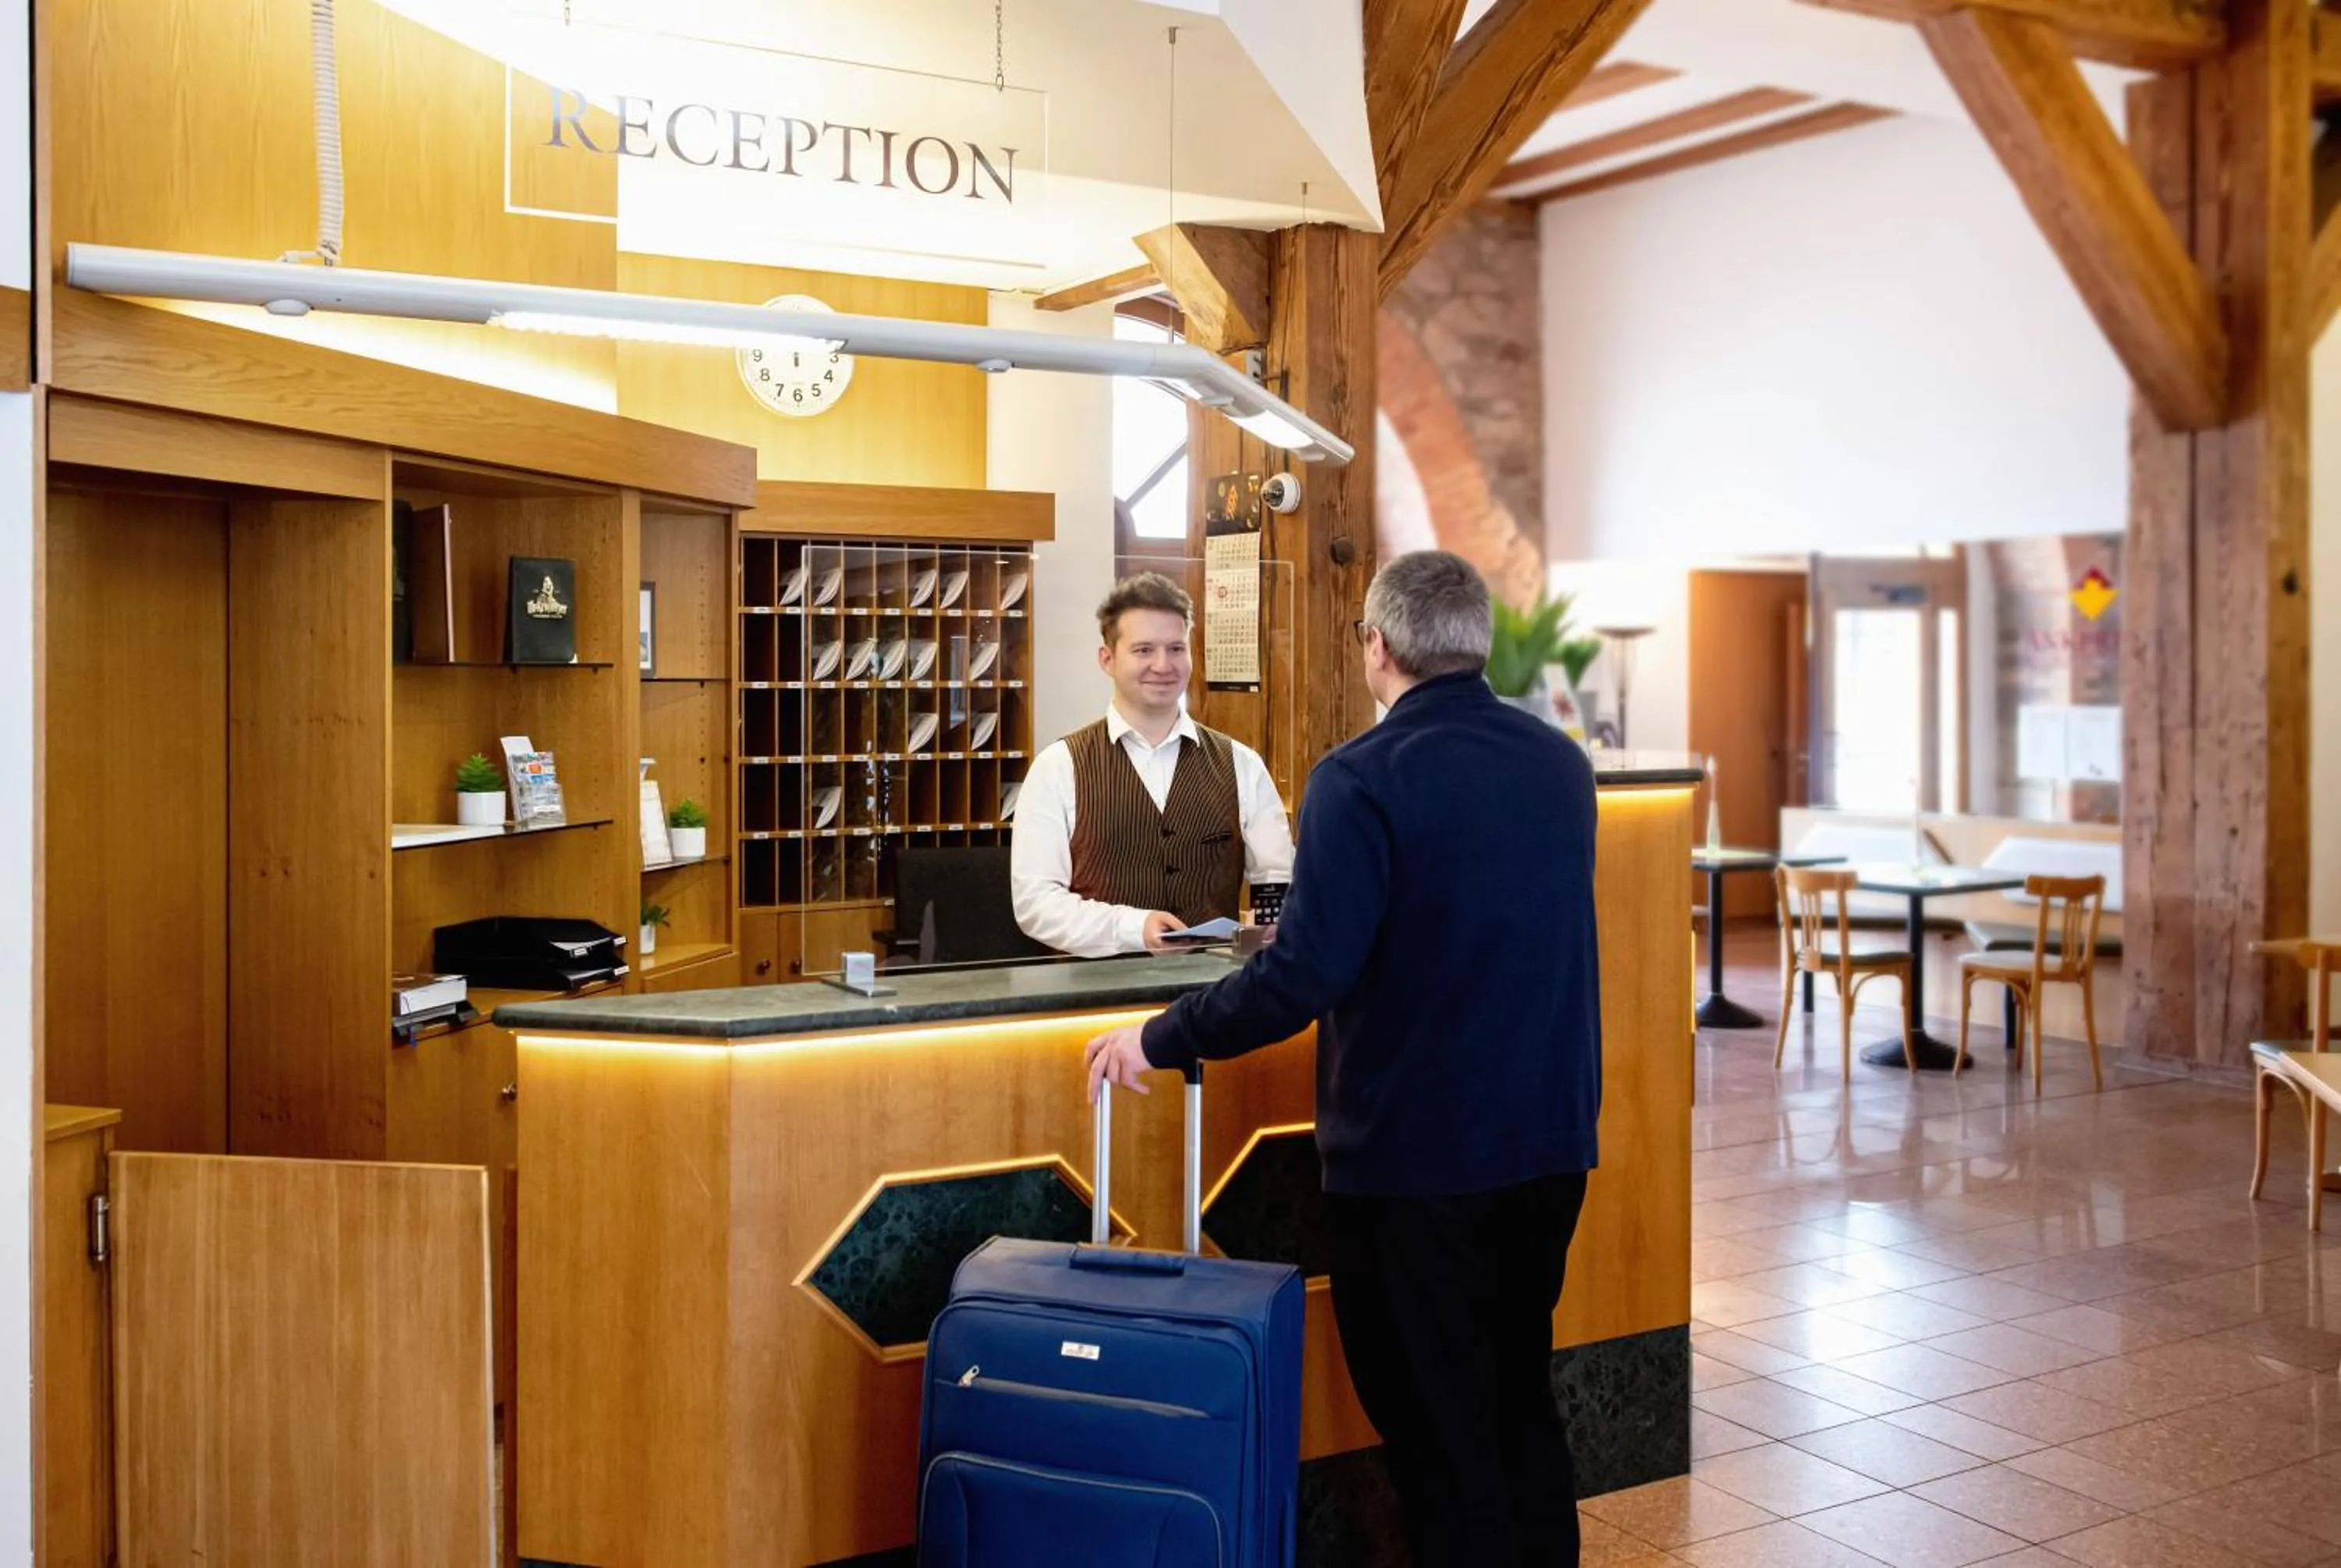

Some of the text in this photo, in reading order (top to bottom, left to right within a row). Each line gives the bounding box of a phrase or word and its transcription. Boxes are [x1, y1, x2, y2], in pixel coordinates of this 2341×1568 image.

[541, 86, 1020, 204] RECEPTION
[752, 349, 762, 362] 9
[760, 368, 770, 381] 8
[823, 370, 833, 382] 4
[775, 383, 784, 397] 7
[793, 388, 803, 402] 6
[812, 383, 821, 397] 5
